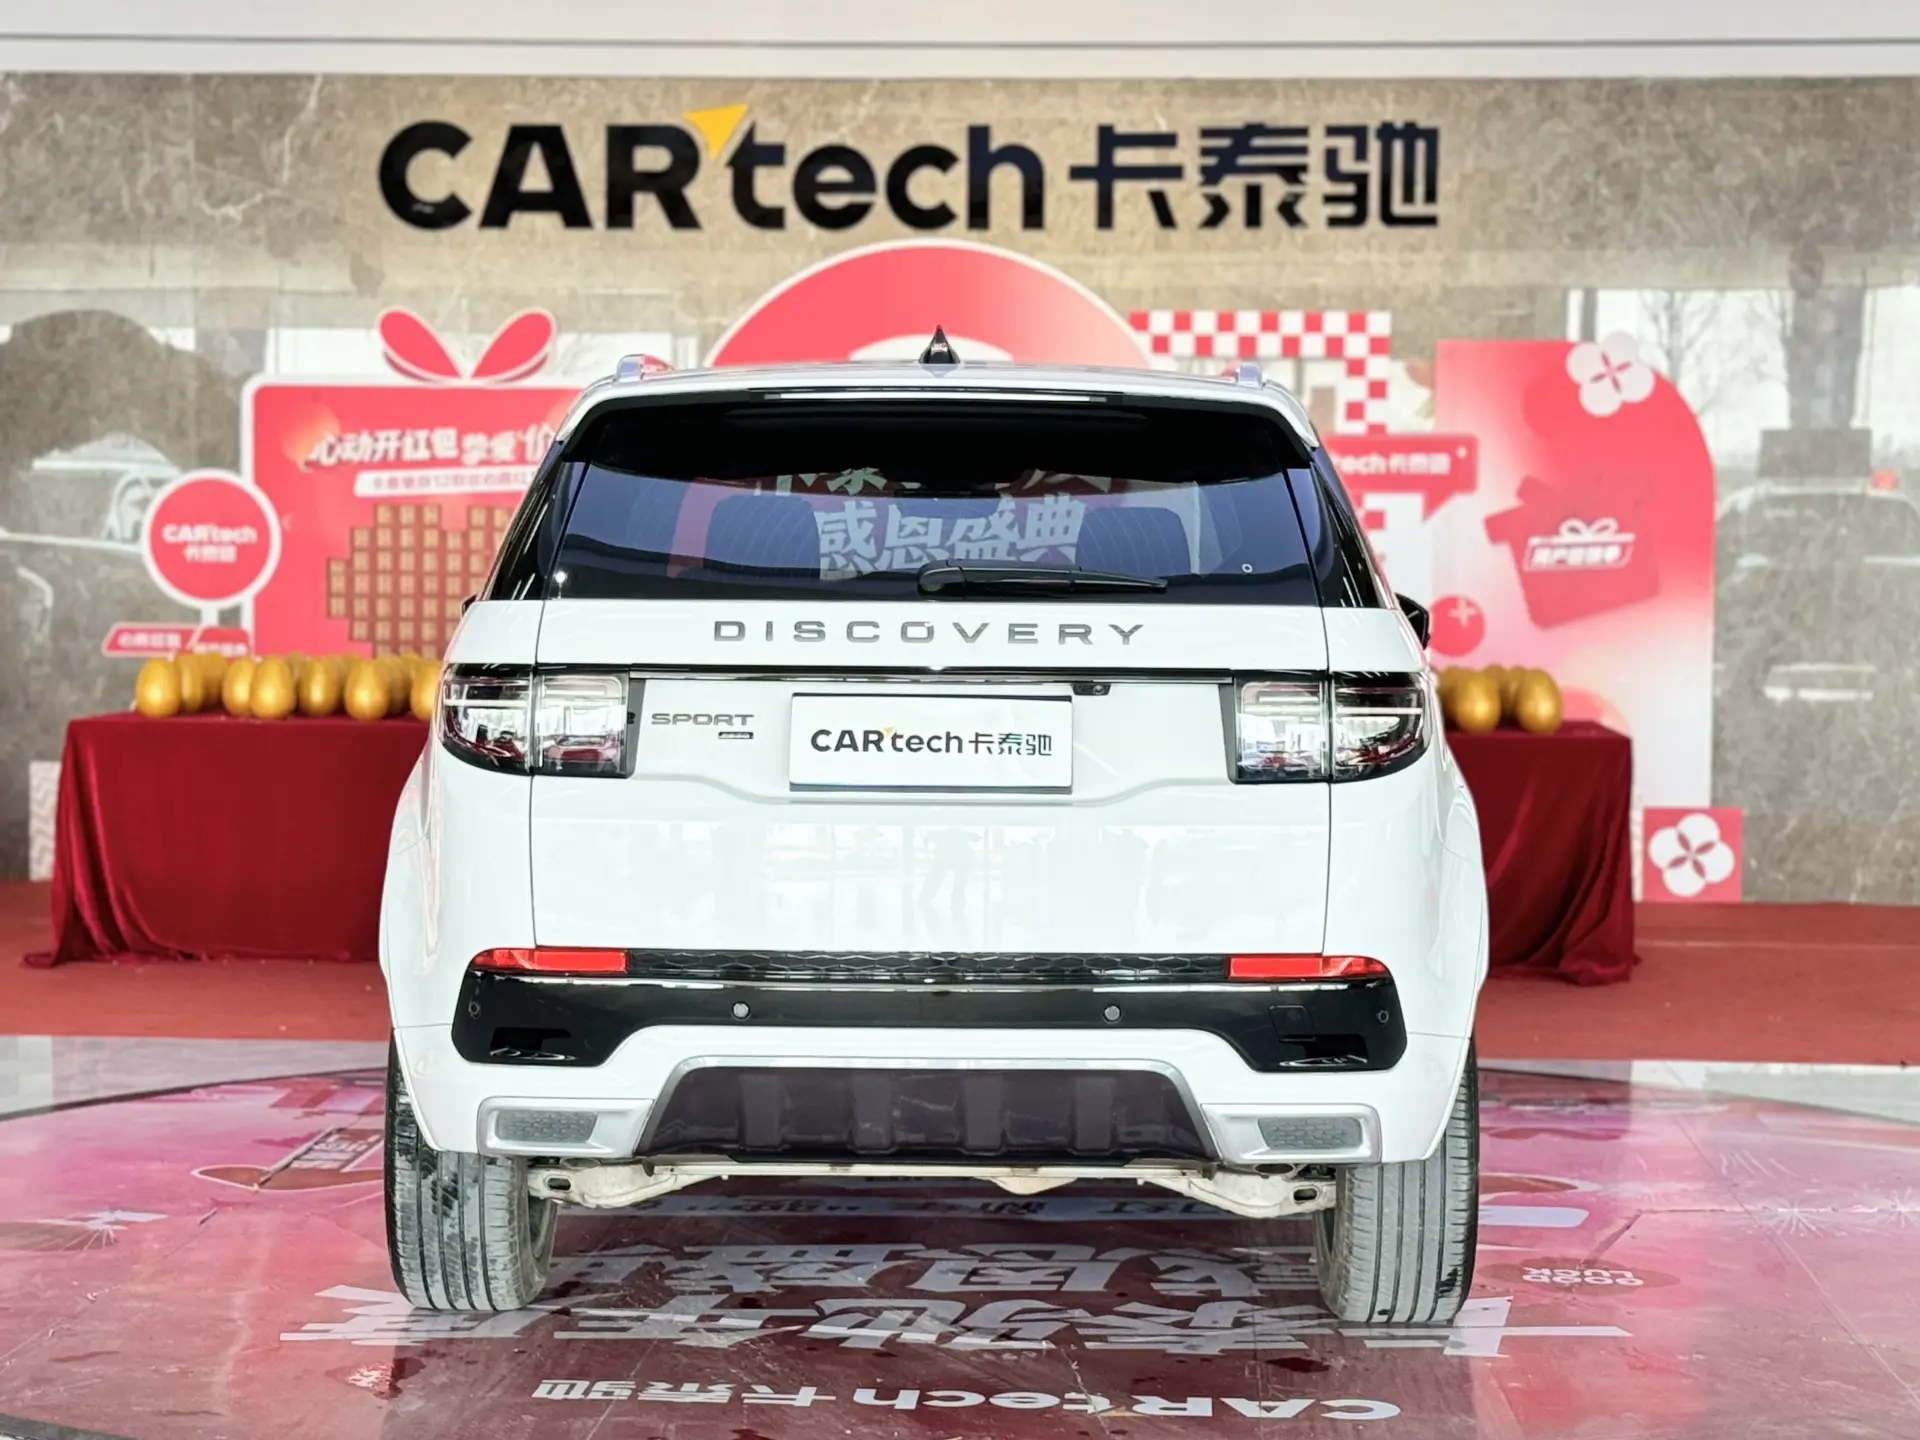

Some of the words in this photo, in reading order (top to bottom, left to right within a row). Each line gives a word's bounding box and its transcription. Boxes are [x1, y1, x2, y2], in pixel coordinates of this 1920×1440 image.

[377, 119, 1047, 231] CARtech
[1069, 121, 1440, 230] 卡泰驰
[813, 492, 1086, 578] 感恩盛典
[713, 618, 1146, 646] DISCOVERY
[650, 712, 755, 726] SPORT
[810, 728, 963, 754] CARtech
[967, 731, 1053, 757] 卡泰驰
[530, 1378, 835, 1408] 卡泰驰
[850, 1387, 1402, 1420] CARtech
